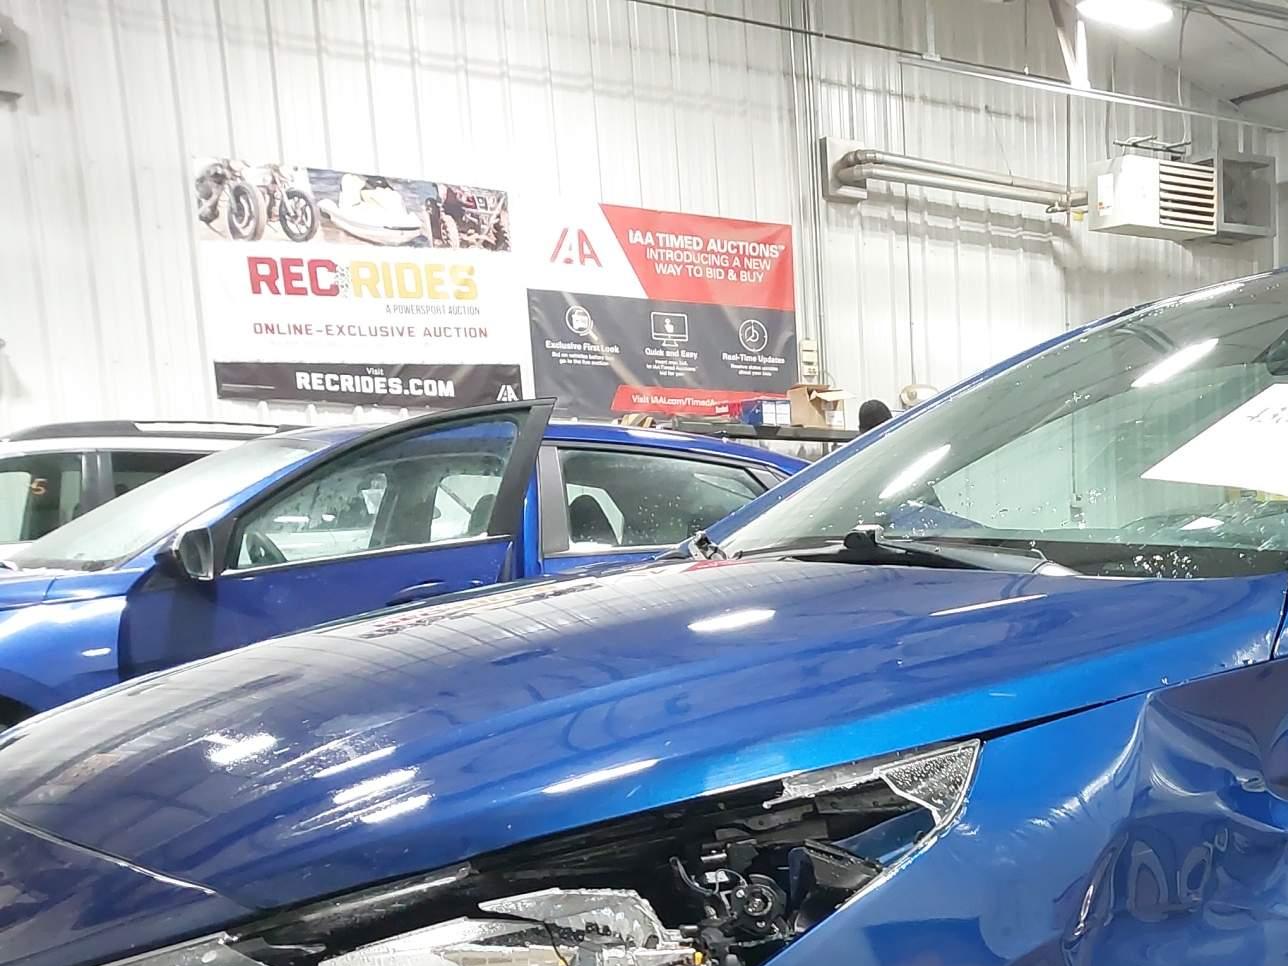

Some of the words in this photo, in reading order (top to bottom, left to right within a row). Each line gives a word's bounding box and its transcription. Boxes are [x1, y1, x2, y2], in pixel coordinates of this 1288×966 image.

[628, 229, 654, 246] IAA
[656, 232, 703, 250] TIMED
[646, 248, 729, 268] INTRODUCING
[732, 258, 742, 268] A
[744, 258, 771, 271] NEW
[655, 263, 682, 276] WAY
[686, 265, 703, 277] TO
[706, 268, 724, 280] BID
[727, 270, 737, 281] &
[740, 271, 764, 283] BUY
[448, 305, 480, 315] AUCTION
[253, 322, 416, 337] ONLINE-EXCLUSIVE
[423, 326, 488, 338] AUCTION
[545, 340, 582, 350] Exclusive
[645, 347, 664, 356] Quick
[680, 350, 698, 360] Easy
[722, 353, 757, 362] Real-Time
[758, 355, 785, 364] Updates
[366, 368, 384, 376] Visit
[296, 372, 455, 397] RECRIDES.COM
[632, 395, 649, 404] Visit
[651, 396, 716, 408] IAAI.com/TimedA
